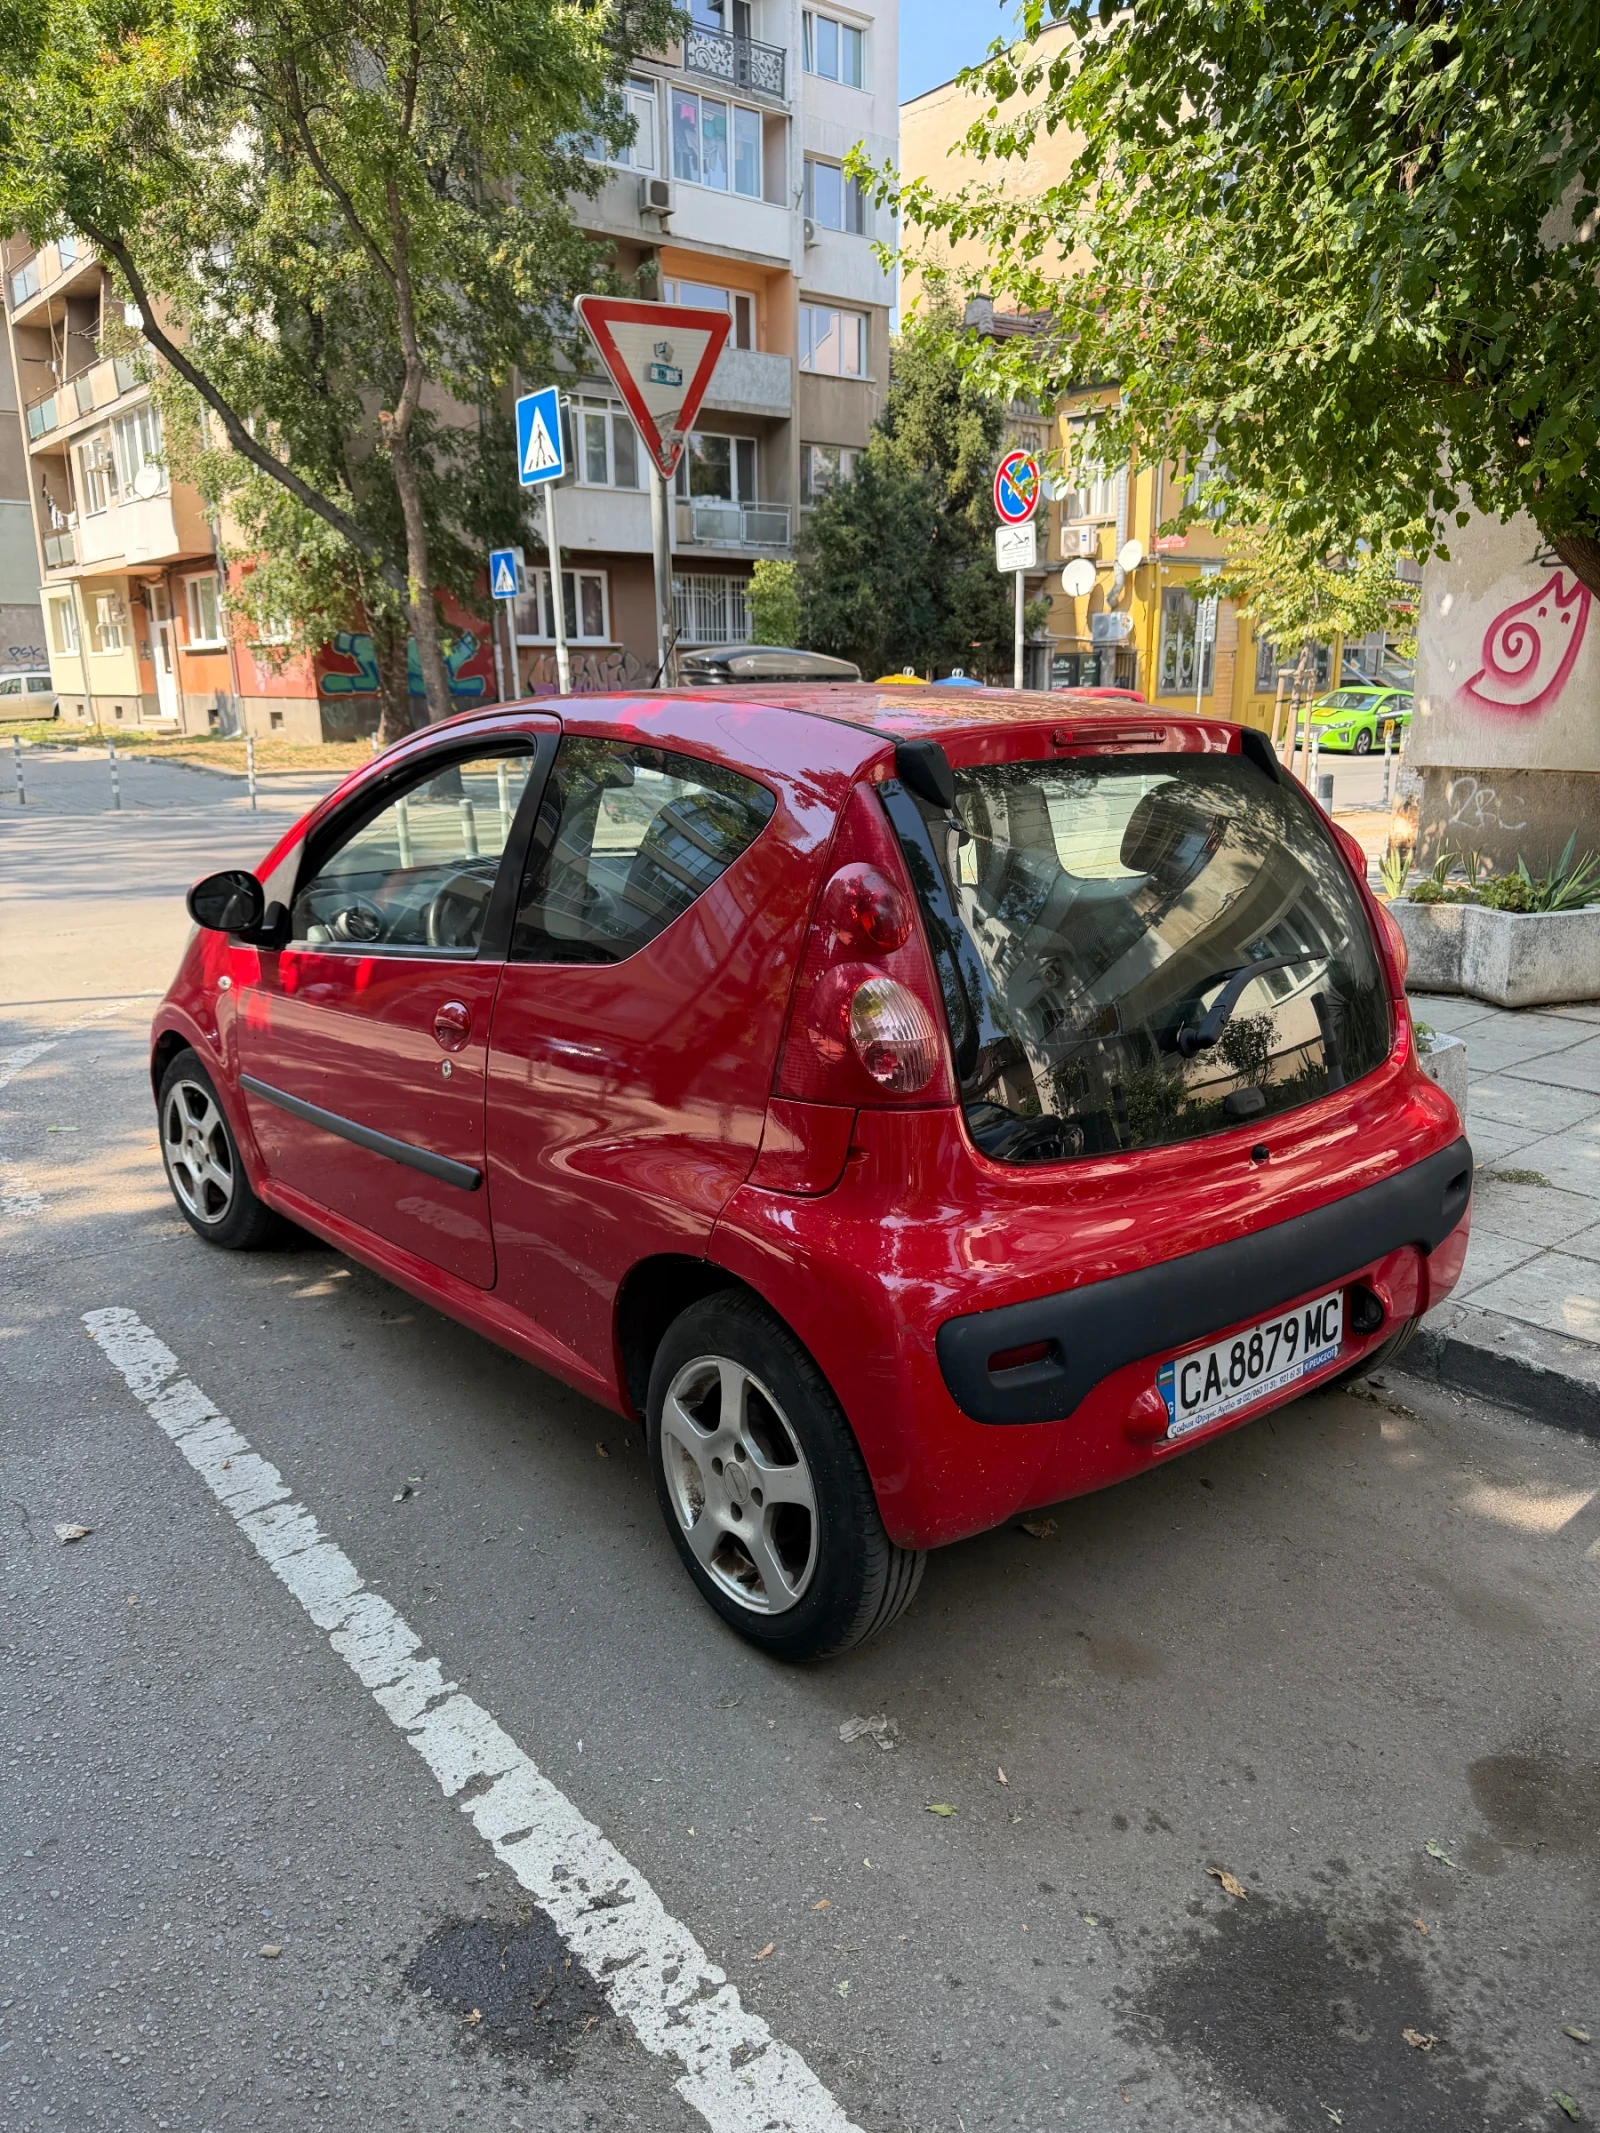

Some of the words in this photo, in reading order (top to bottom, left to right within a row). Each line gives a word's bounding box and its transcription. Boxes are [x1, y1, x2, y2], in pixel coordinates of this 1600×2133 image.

[1181, 1352, 1222, 1410] CA
[1229, 1317, 1300, 1388] 8879
[1304, 1298, 1338, 1354] MC
[1309, 1348, 1335, 1369] PEUGEOT
[1171, 1420, 1194, 1435] София
